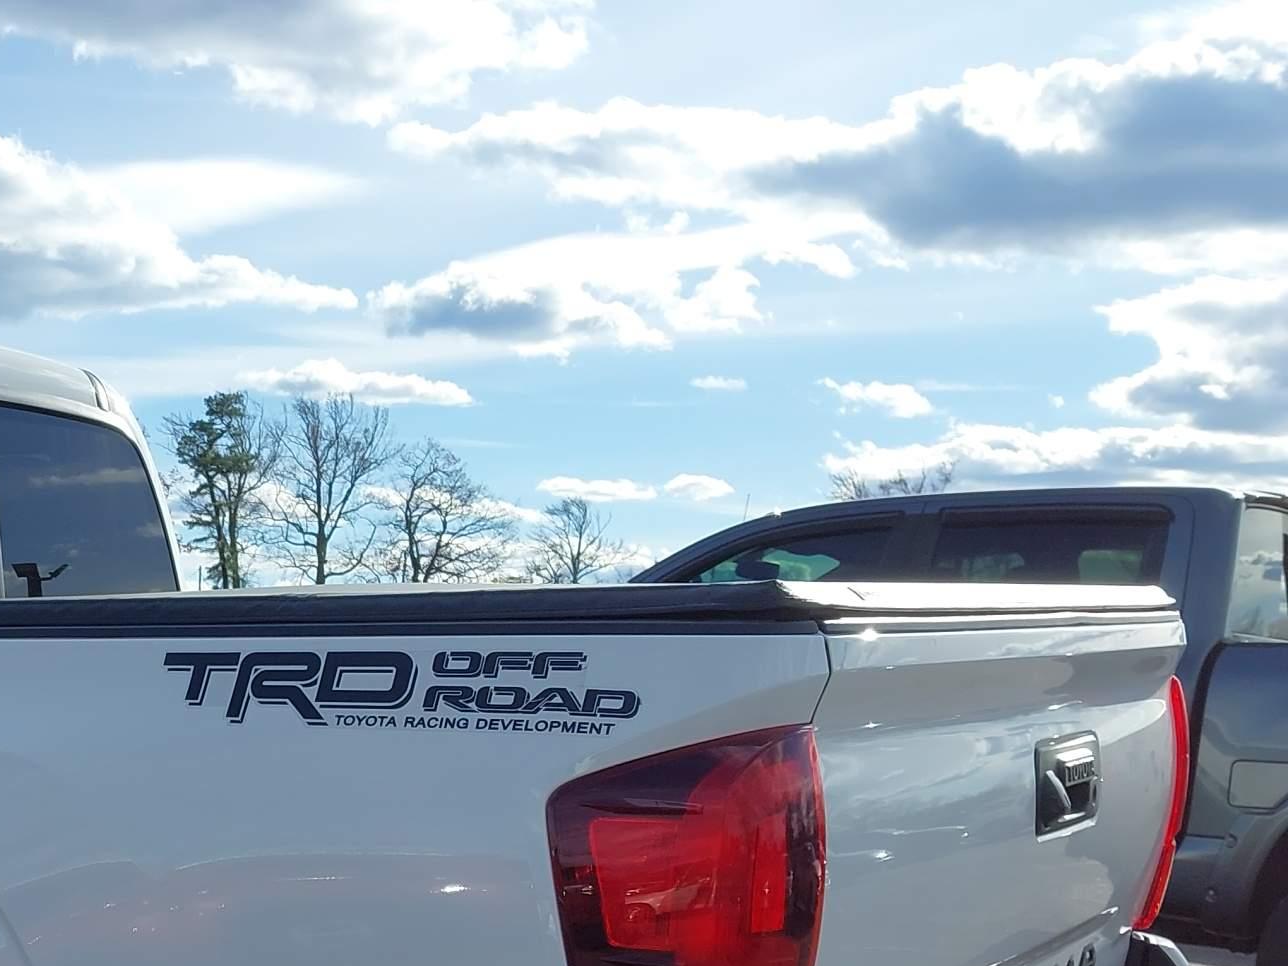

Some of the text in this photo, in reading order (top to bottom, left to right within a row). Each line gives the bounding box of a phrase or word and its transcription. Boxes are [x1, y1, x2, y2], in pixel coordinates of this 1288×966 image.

[431, 650, 588, 679] OFF
[163, 650, 419, 727] TRD
[421, 685, 642, 719] ROAD
[334, 714, 616, 737] TOYOTA RACING DEVELOPMENT
